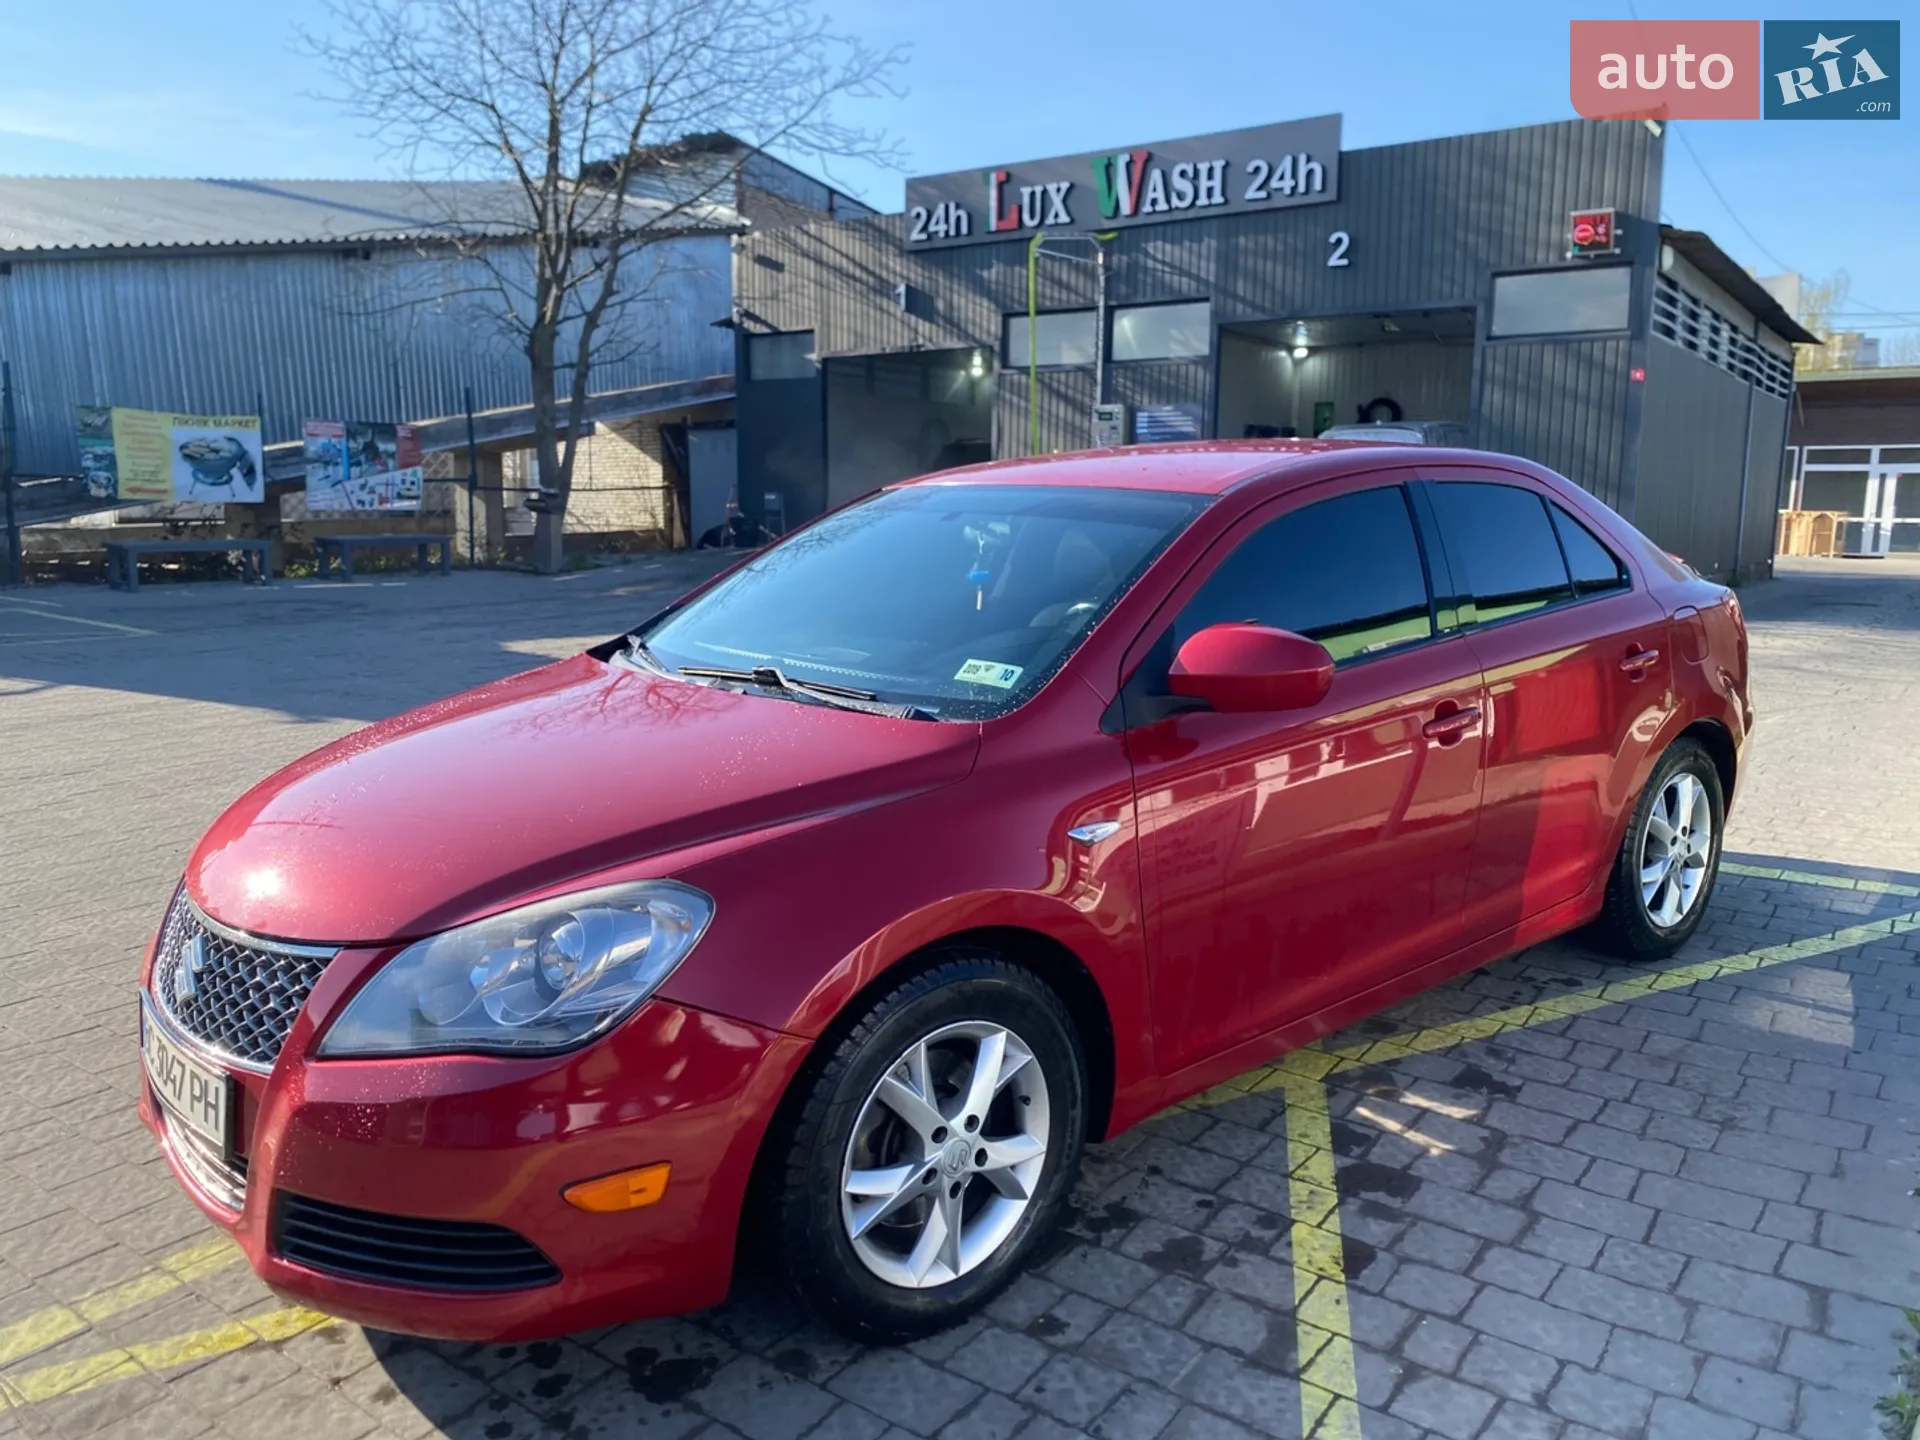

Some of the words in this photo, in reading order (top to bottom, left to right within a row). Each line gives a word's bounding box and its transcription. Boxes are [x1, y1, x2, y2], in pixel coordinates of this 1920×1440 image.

[909, 201, 970, 242] 24h
[1243, 152, 1324, 201] 24h
[1327, 231, 1350, 267] 2
[894, 283, 906, 312] 1
[1000, 668, 1015, 682] 10
[156, 1034, 186, 1102] 3047
[190, 1068, 219, 1133] PH
